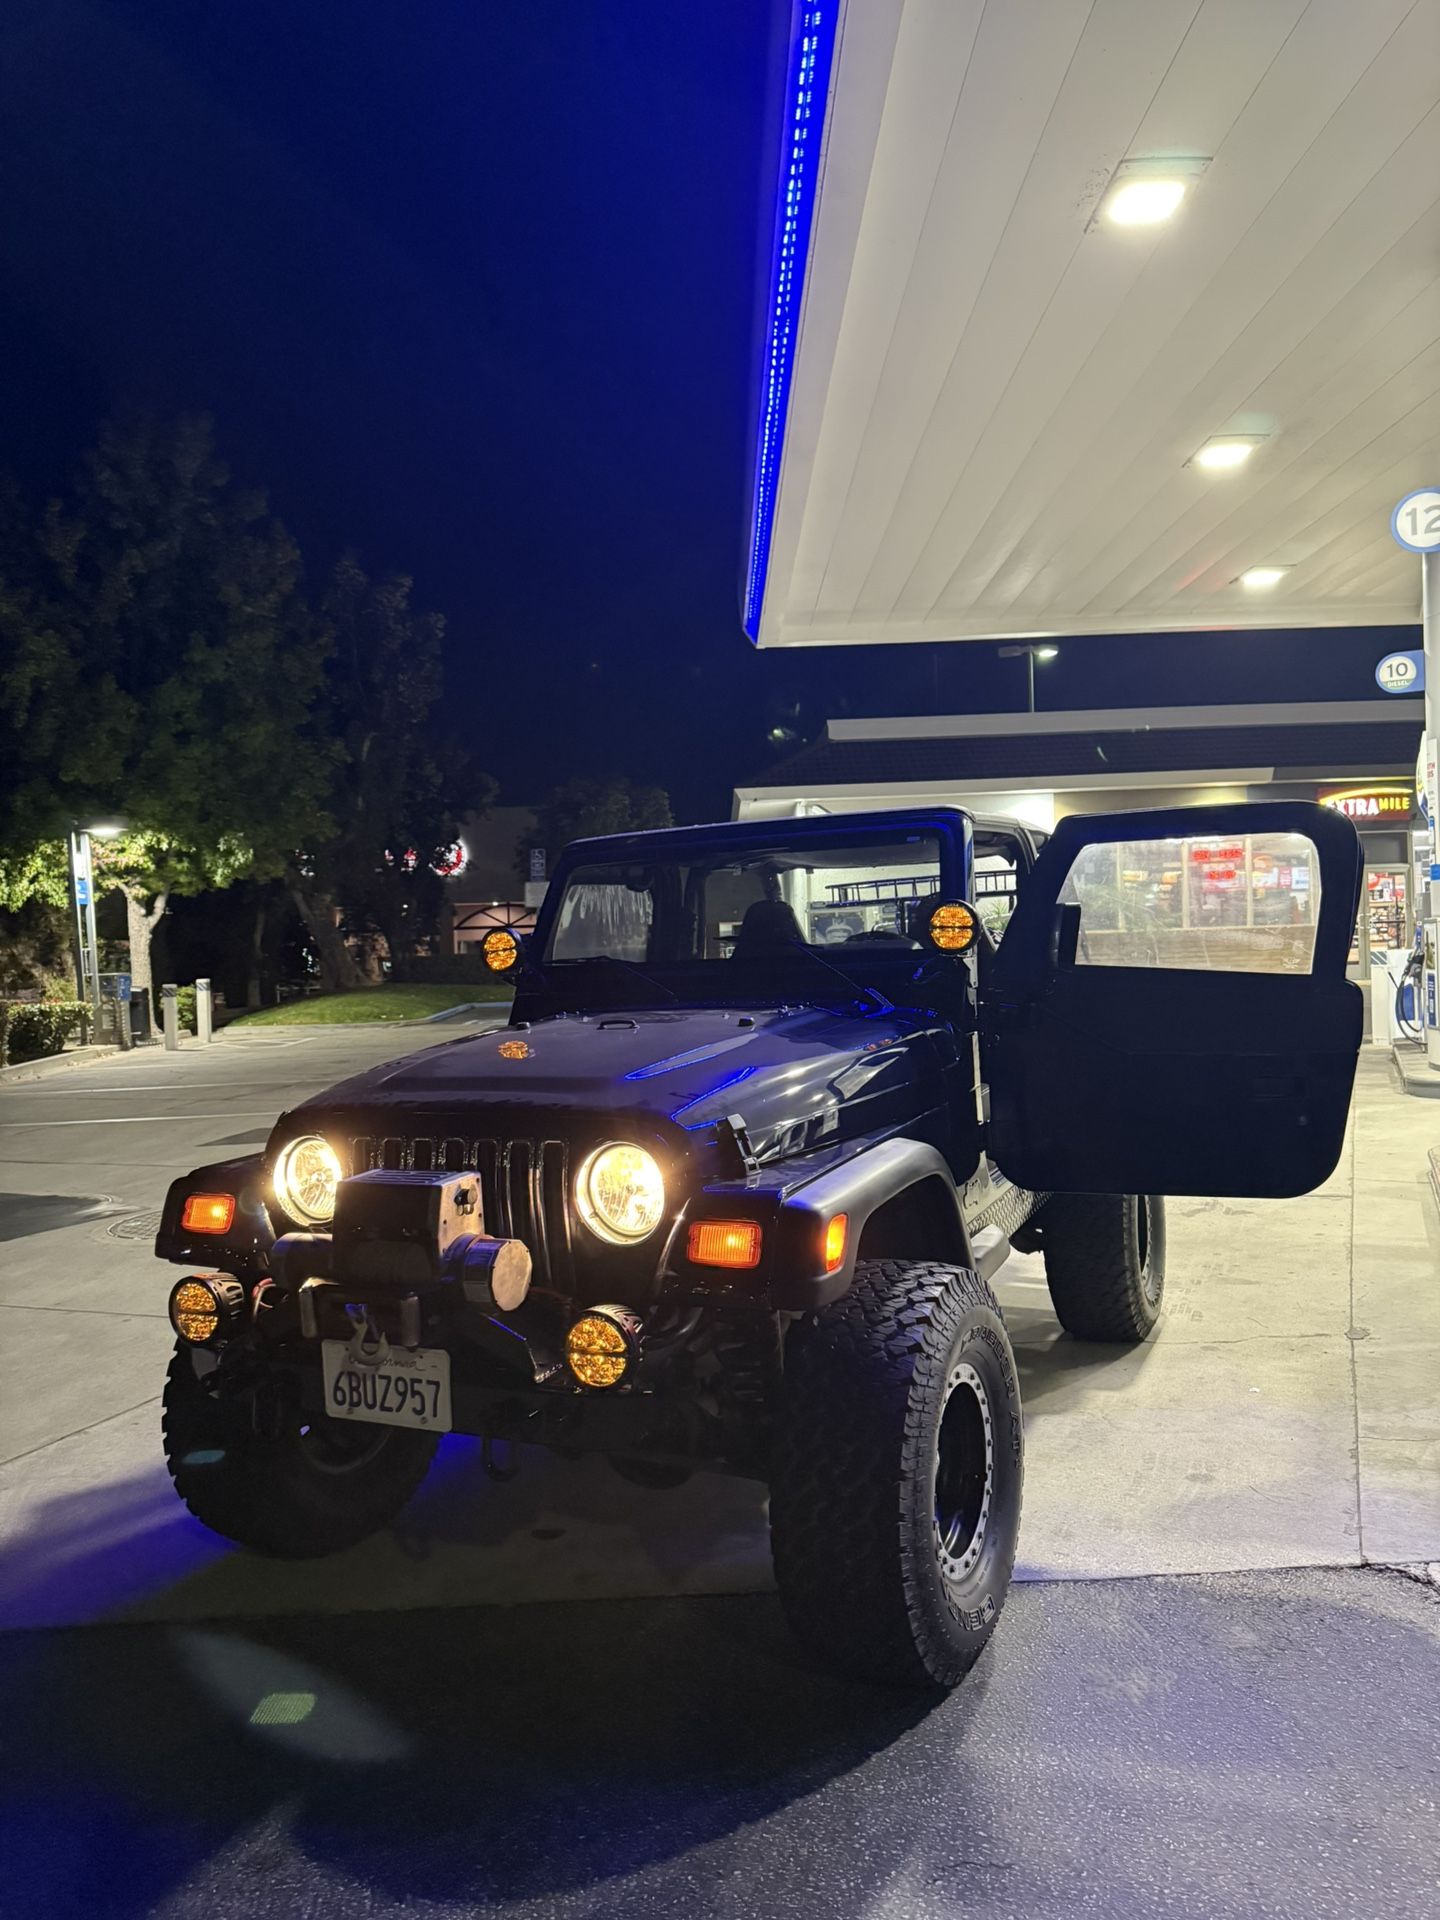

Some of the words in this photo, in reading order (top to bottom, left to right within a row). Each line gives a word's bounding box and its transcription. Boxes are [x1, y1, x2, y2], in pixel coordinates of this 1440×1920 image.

[1405, 504, 1440, 536] 12
[1386, 662, 1408, 678] 10
[1387, 679, 1409, 688] DIESEL
[333, 1370, 441, 1418] 6BUZ957
